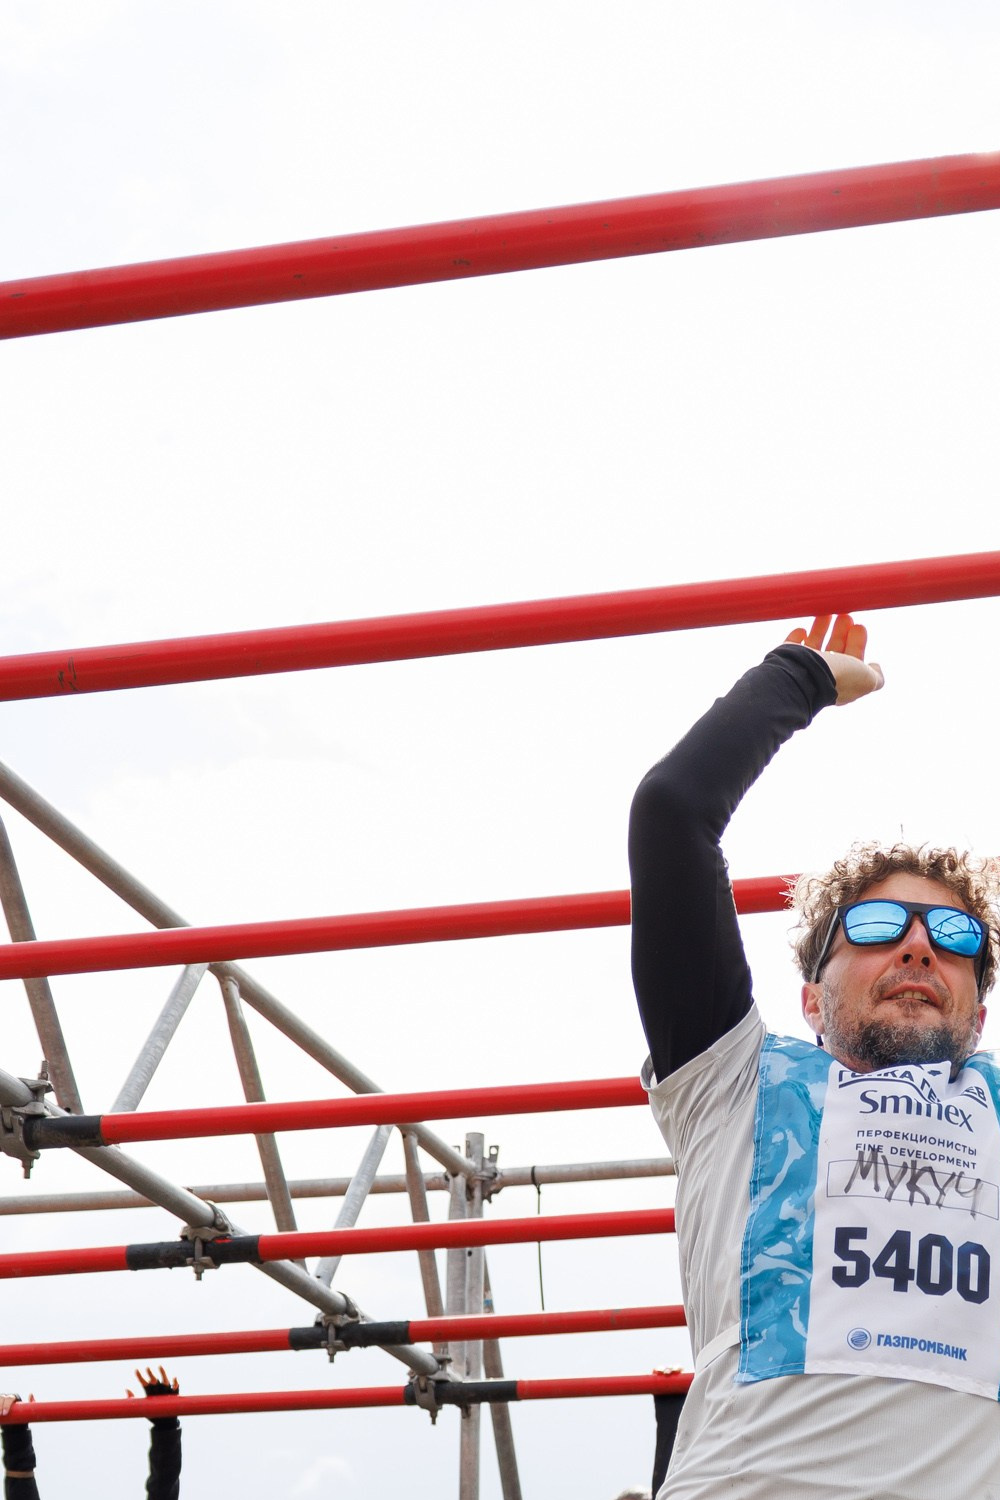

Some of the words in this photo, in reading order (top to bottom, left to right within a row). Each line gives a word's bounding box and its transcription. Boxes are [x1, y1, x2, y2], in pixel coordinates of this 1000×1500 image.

[838, 1069, 914, 1082] ГКА
[859, 1089, 974, 1133] Sminex
[855, 1143, 884, 1153] FINE
[890, 1146, 977, 1169] DEVELOPMENT
[856, 1129, 977, 1156] ПЕРФЕКЦИОНИСТЫ
[831, 1226, 991, 1305] 5400
[876, 1334, 968, 1361] ГАЗПРОМБАНК
